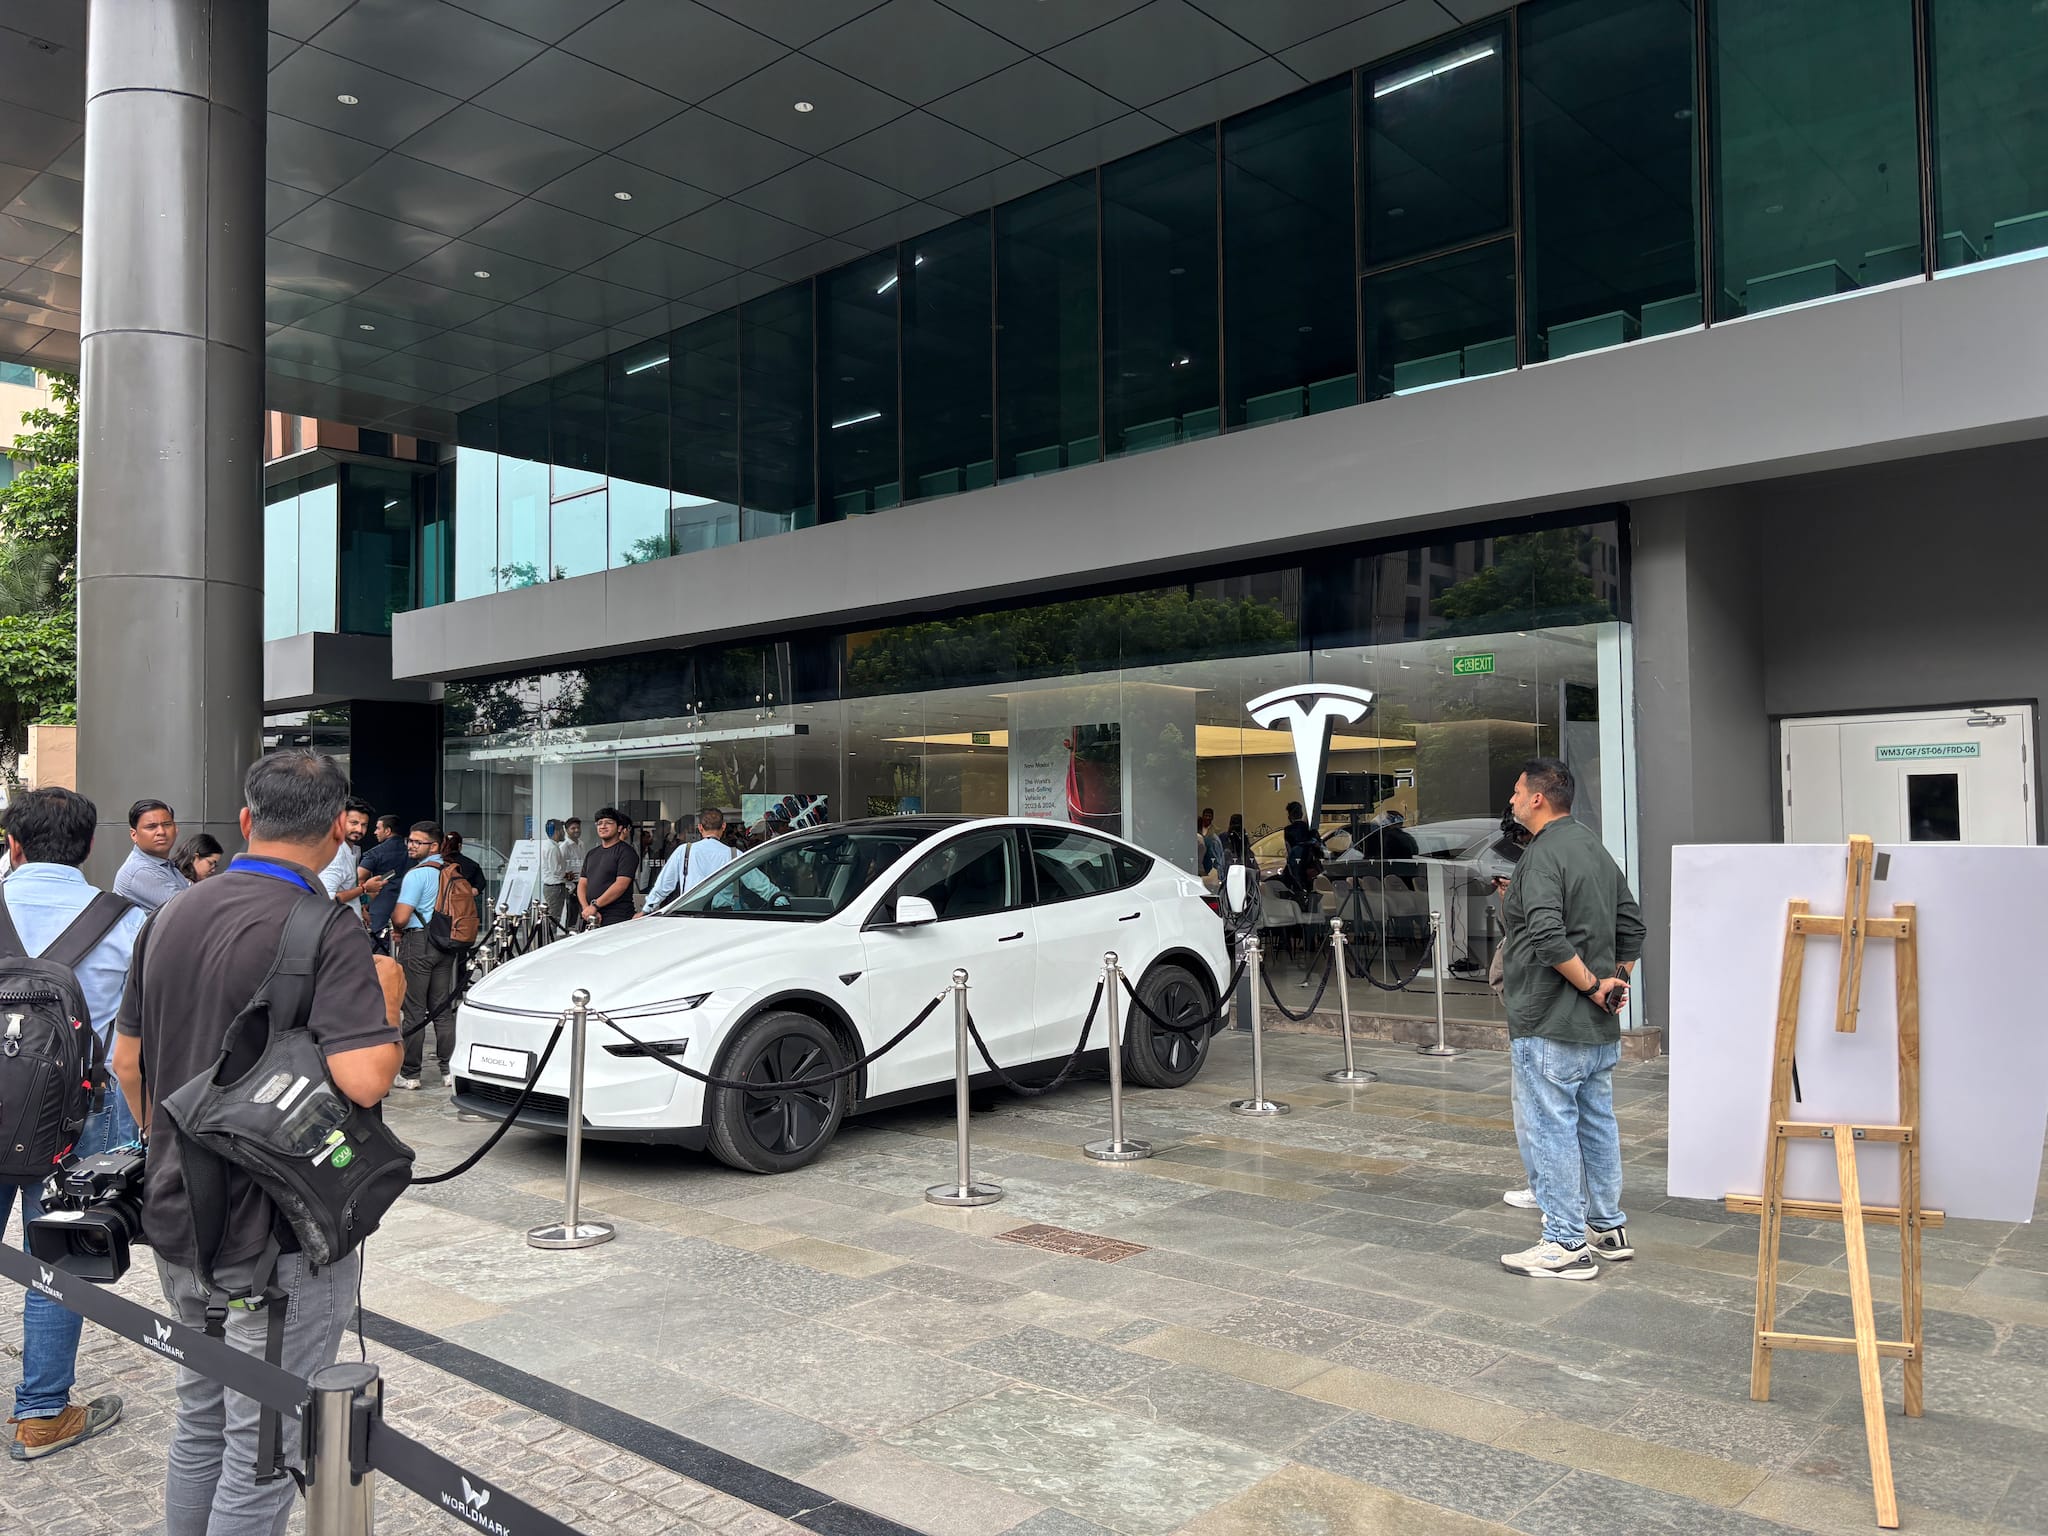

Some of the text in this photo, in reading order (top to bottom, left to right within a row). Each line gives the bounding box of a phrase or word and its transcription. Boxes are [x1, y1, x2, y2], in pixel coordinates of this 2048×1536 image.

[1475, 656, 1492, 670] EXIT
[1880, 745, 1976, 757] WM3/GF/ST-06/FRD-06
[481, 1056, 516, 1068] MODEL Y
[333, 1146, 351, 1163] TVU
[31, 1279, 64, 1301] WORLDMARK
[143, 1334, 185, 1360] WORLDMARK
[441, 1490, 511, 1536] WORLDMARK
